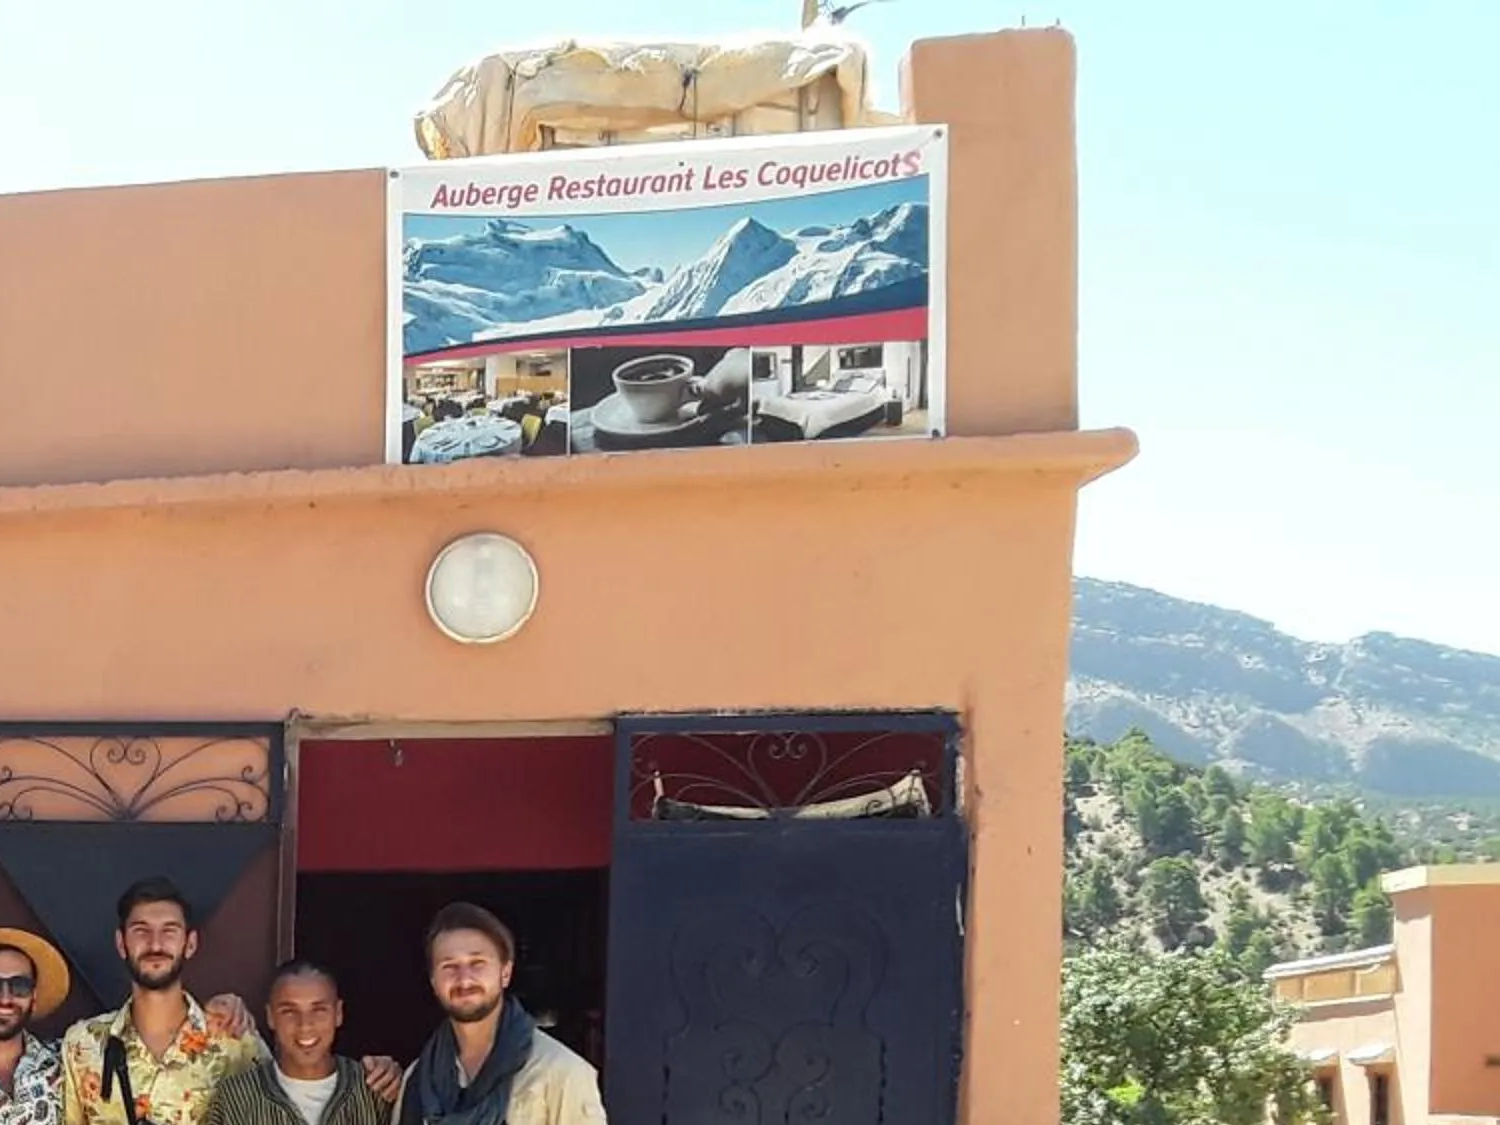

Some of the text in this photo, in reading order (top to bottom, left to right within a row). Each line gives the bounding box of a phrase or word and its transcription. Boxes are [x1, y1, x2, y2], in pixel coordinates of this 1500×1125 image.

[430, 182, 539, 209] Auberge
[547, 167, 695, 200] Restaurant
[702, 165, 748, 190] Les
